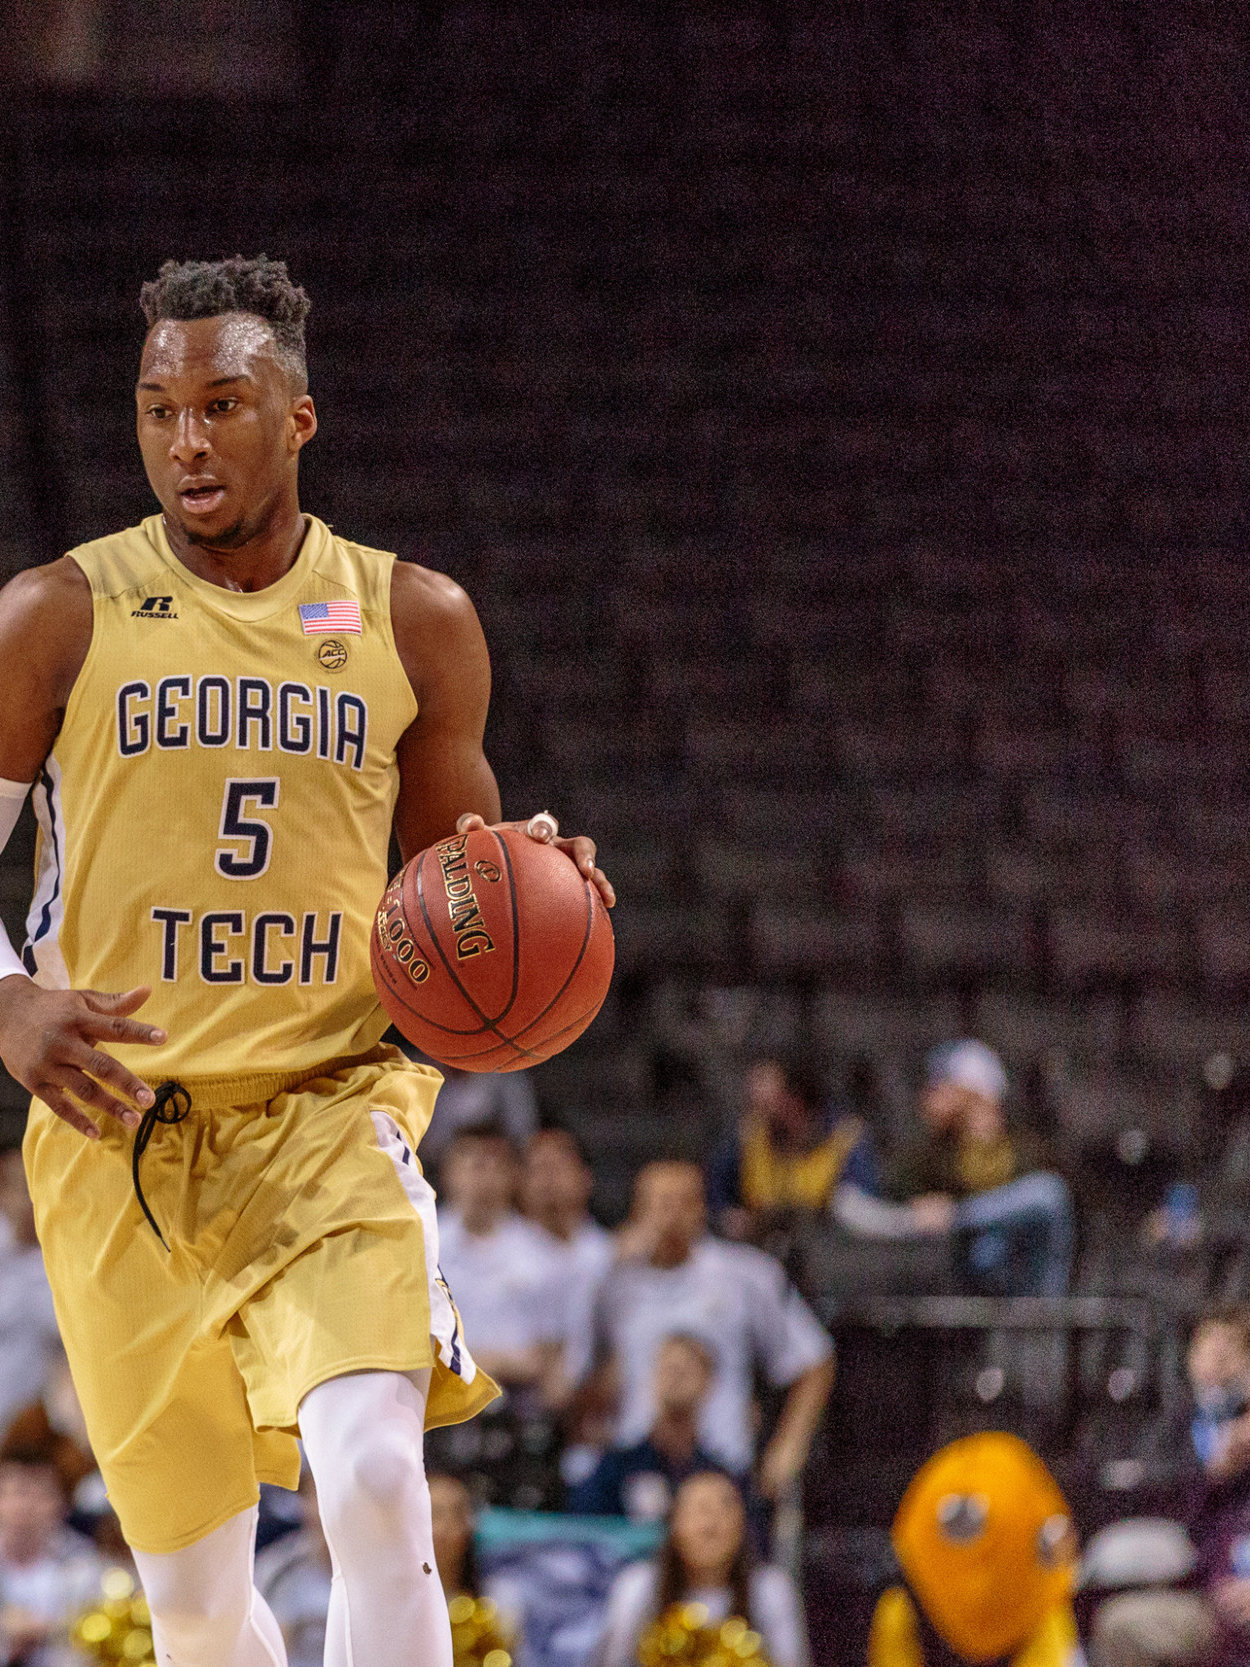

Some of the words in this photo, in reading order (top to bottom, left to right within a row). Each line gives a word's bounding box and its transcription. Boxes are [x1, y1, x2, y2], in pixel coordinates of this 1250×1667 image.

[130, 610, 180, 620] RUSSELL
[321, 648, 344, 659] ACC
[117, 673, 367, 772] GEORGIA
[214, 776, 280, 880] 5
[436, 833, 496, 961] PALDING
[150, 905, 344, 985] TECH
